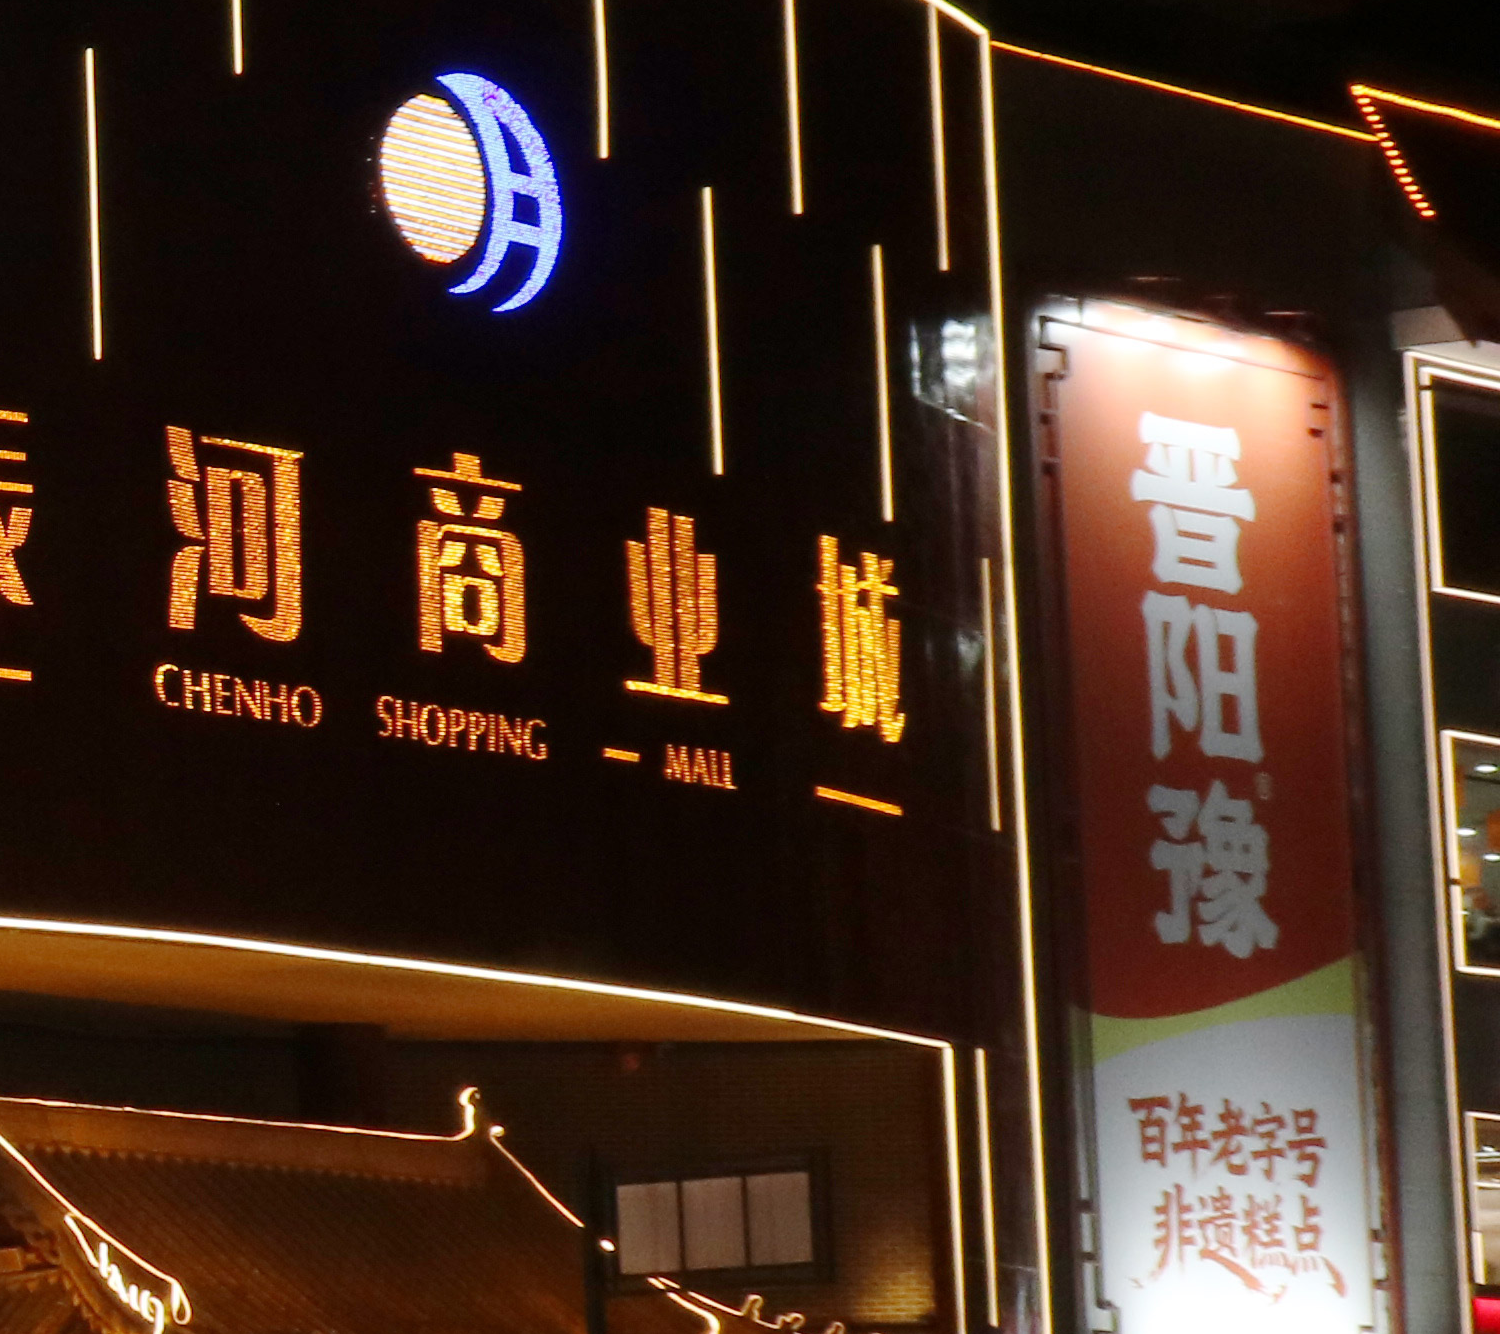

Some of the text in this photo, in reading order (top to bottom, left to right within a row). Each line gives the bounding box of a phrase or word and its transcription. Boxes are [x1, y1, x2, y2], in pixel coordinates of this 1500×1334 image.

[153, 662, 737, 791] CHENHO SHOPPING MALL
[1130, 410, 1279, 960] 晋阳豫
[1127, 1092, 1328, 1188] 百年老字号
[1153, 1182, 1348, 1300] 非遗糕点
